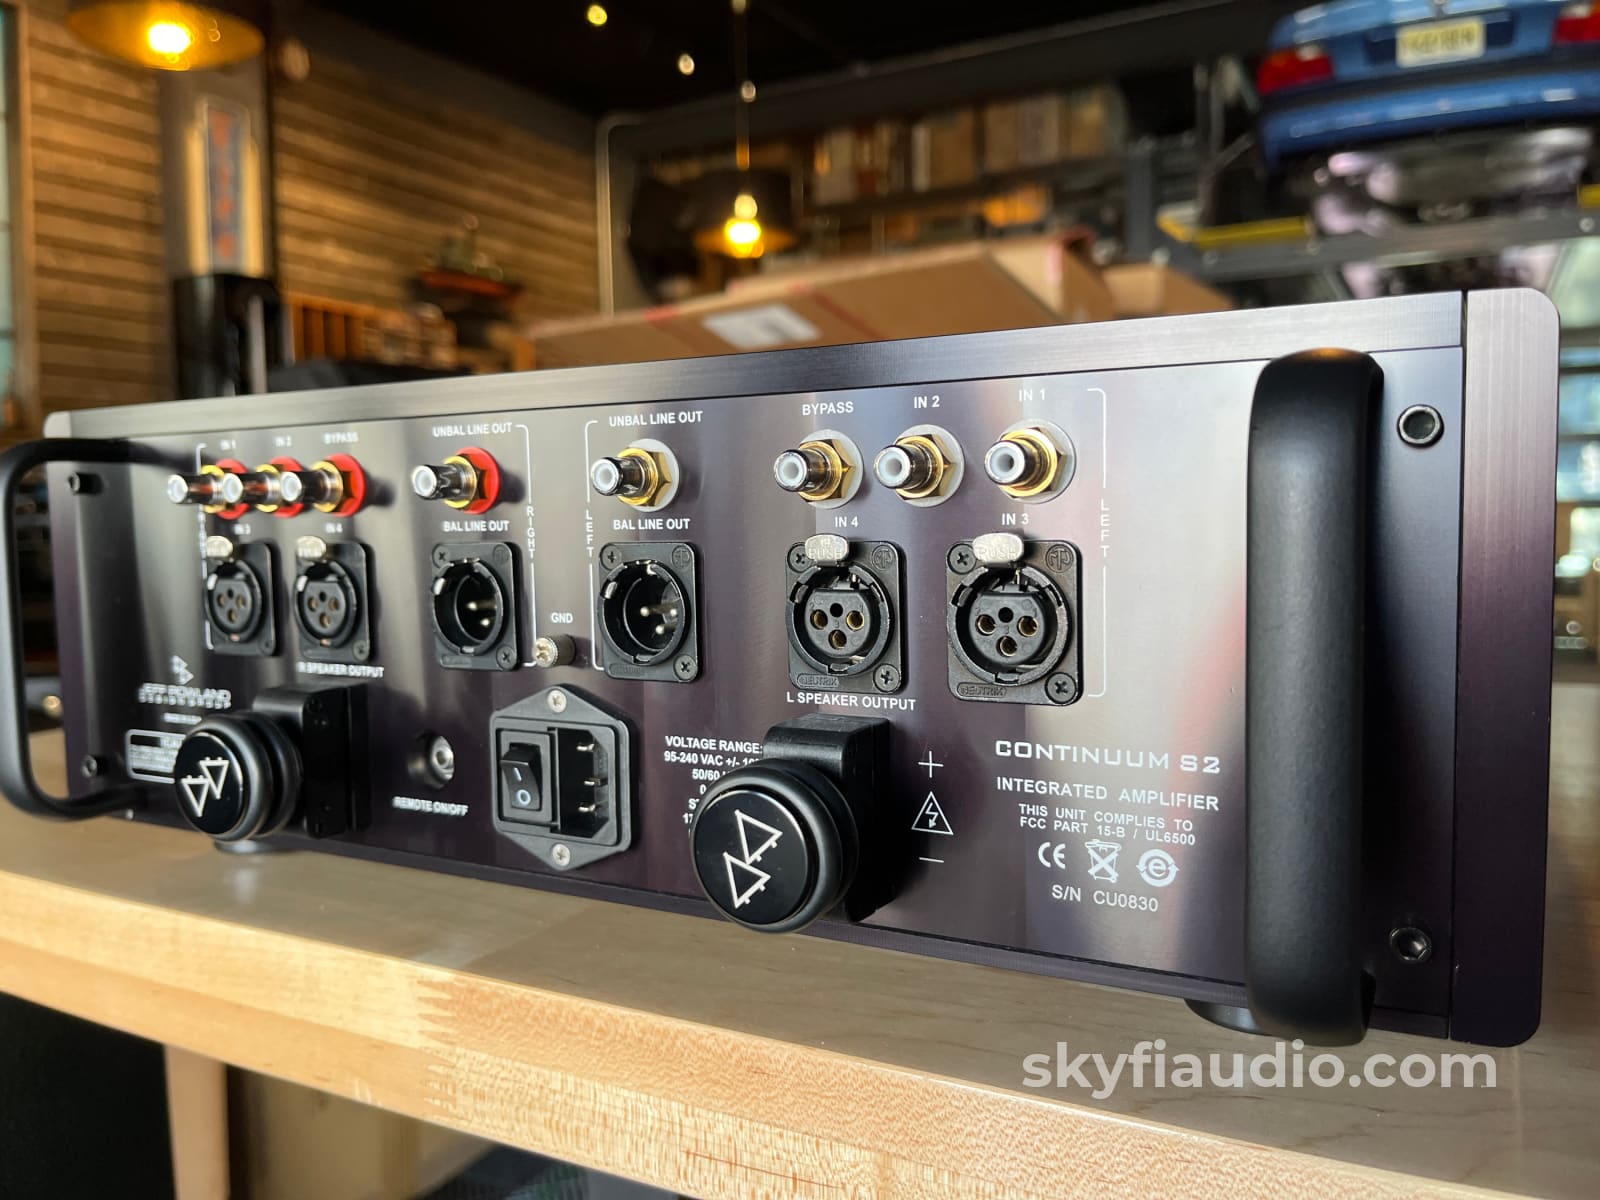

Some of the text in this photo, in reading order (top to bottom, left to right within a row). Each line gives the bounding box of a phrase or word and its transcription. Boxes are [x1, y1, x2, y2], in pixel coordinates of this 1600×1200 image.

[913, 395, 941, 409] IN 2
[1018, 388, 1046, 402] IN 1
[802, 401, 854, 416] BYPASS
[609, 411, 703, 427] UNBAL LINE OUT
[432, 422, 512, 437] UNBAL LINE OUT
[323, 432, 359, 444] BYPASS
[443, 520, 510, 532] BAL LINE OUT
[613, 518, 690, 530] BAL LINE OUT
[834, 516, 859, 528] IN 4
[1001, 513, 1029, 525] IN 3
[526, 506, 536, 559] RIGHT
[586, 509, 594, 558] LEFT
[1100, 498, 1110, 558] LEFT
[551, 612, 574, 624] GND
[348, 664, 385, 678] OUTPUT
[786, 692, 916, 711] L SPEAKER OUTPUT
[664, 735, 763, 754] VOLTAGE RANGE:
[664, 750, 699, 764] 95-240
[700, 753, 723, 766] VAC
[725, 756, 740, 767] +/-
[995, 740, 1221, 774] CONTINUUM S2
[692, 768, 720, 781] 50/60
[996, 776, 1219, 811] INTEGRATED AMPLIFIER
[1019, 803, 1193, 831] THIS UNIT COMPLIES TO
[1019, 816, 1047, 830] FCC
[1053, 820, 1088, 834] PART
[1097, 825, 1126, 838] 15-B
[1145, 830, 1196, 846] UL6500
[1037, 841, 1066, 870] CE
[1051, 884, 1159, 912] S/N CU0830
